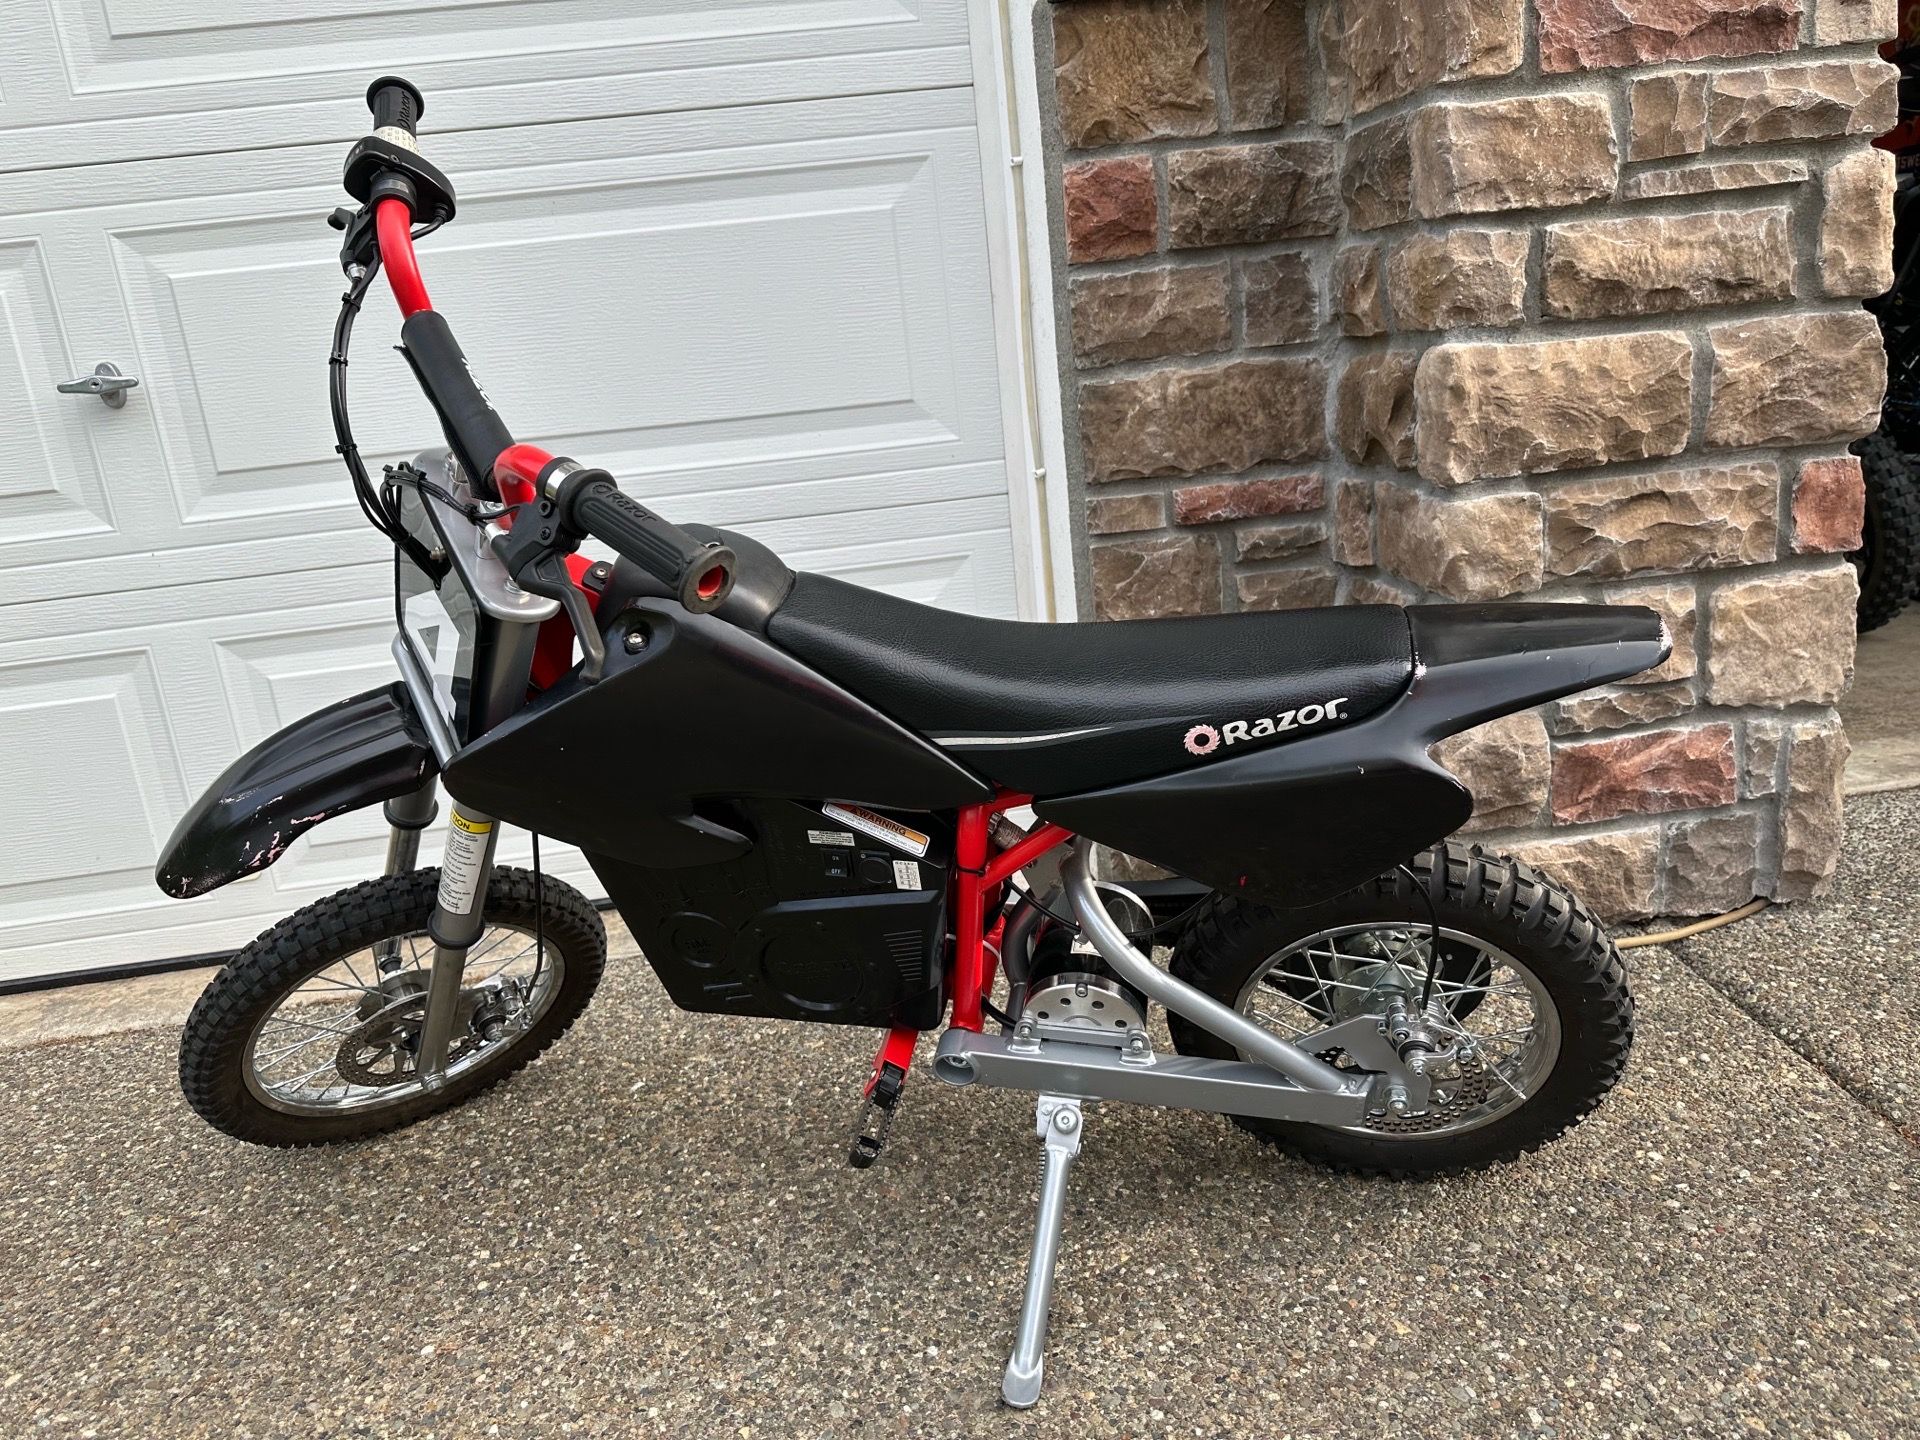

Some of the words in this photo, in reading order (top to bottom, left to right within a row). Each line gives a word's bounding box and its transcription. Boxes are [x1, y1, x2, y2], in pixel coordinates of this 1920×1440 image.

[399, 91, 411, 121] Razor
[606, 492, 657, 521] Razor
[1222, 698, 1348, 745] Razor
[857, 809, 906, 835] WARNING
